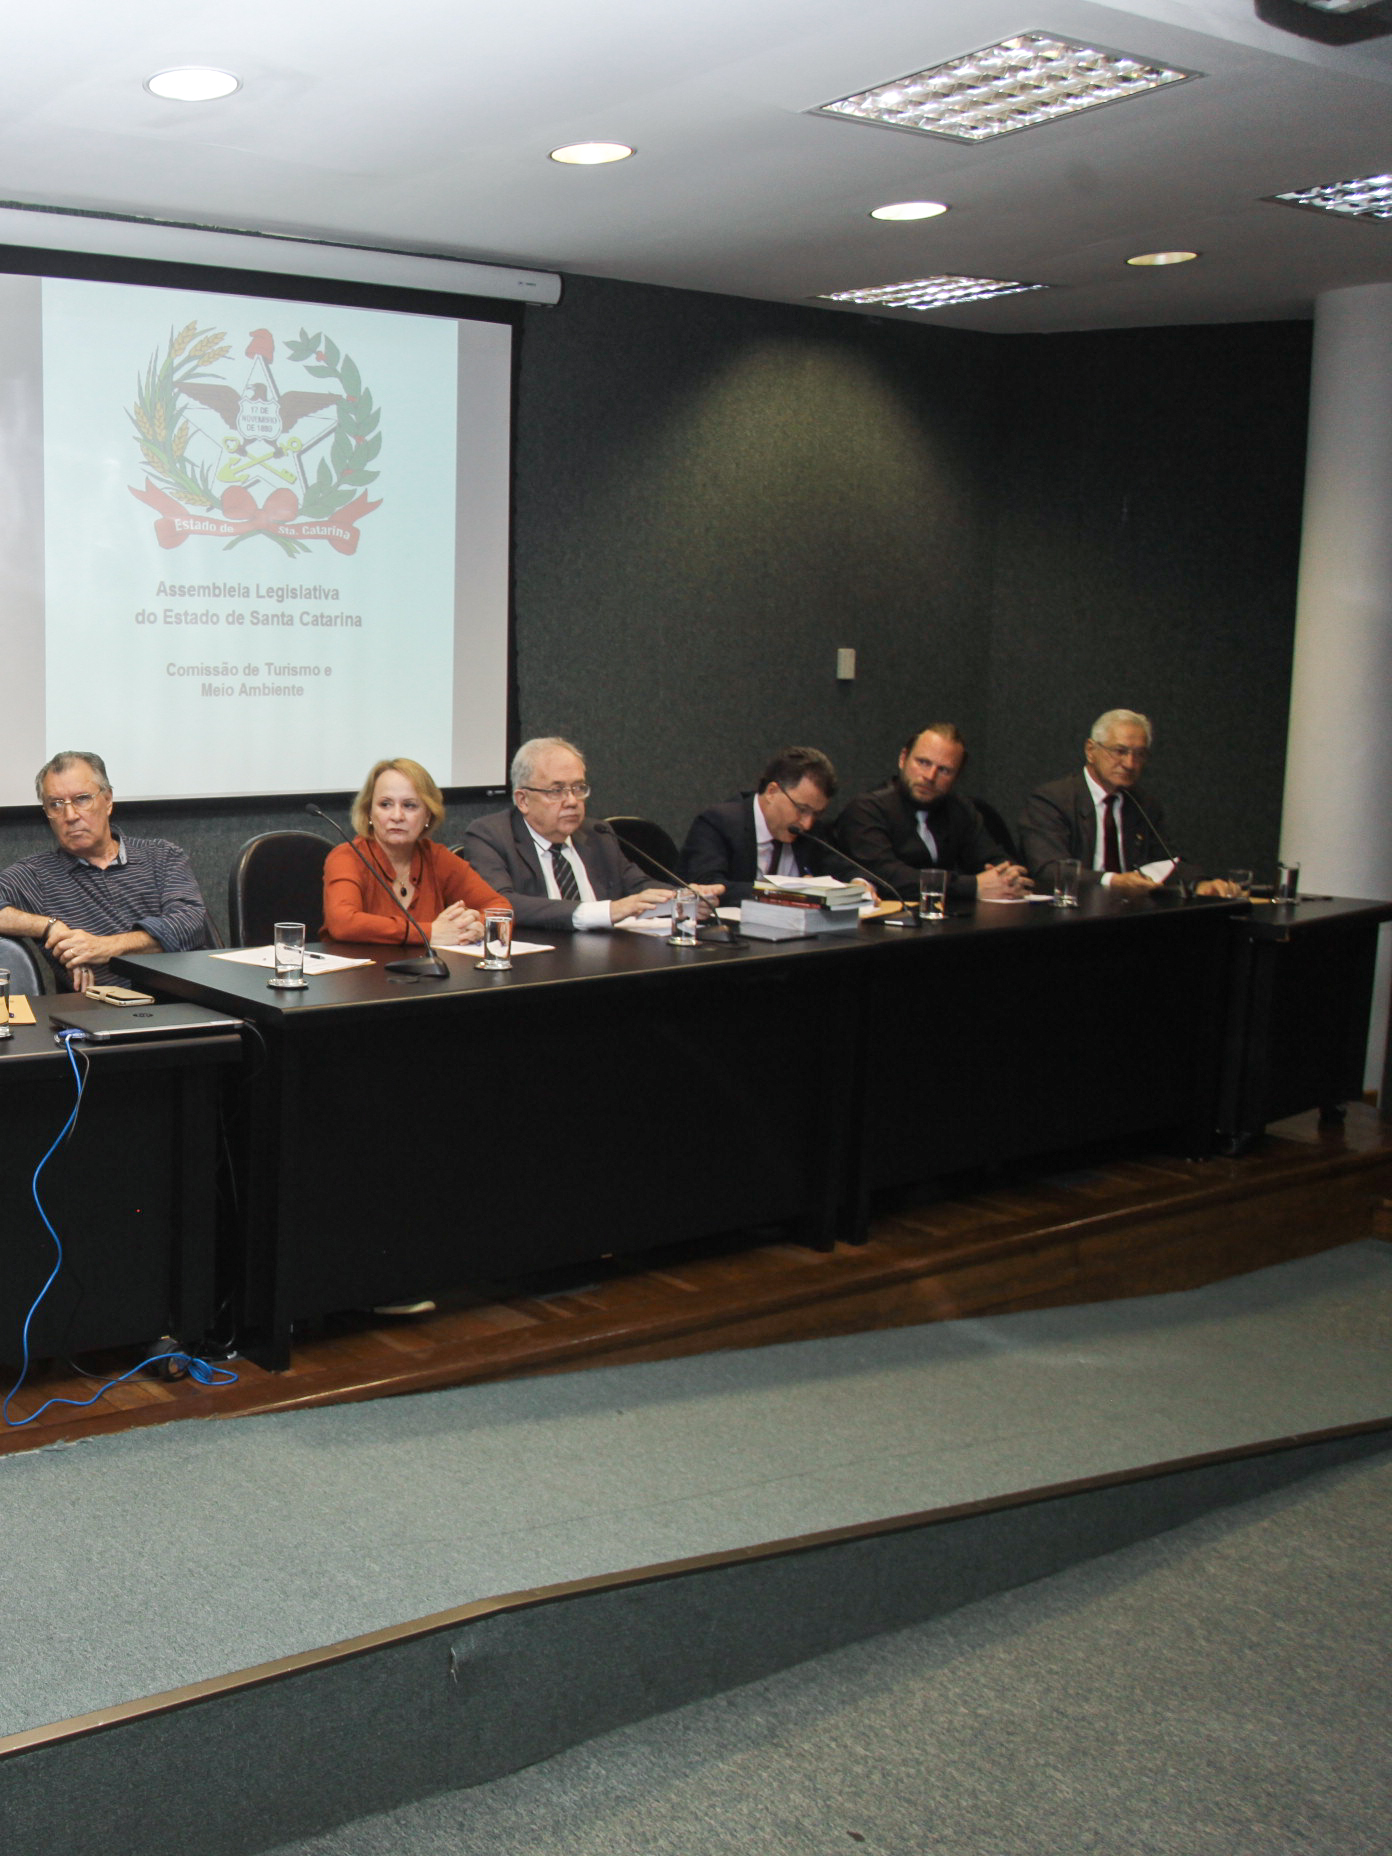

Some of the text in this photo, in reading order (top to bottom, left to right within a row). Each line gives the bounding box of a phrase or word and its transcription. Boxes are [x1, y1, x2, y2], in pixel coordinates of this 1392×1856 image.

[174, 518, 234, 533] Estado de
[278, 525, 350, 540] Sta. Catarina
[156, 581, 340, 603] Assembleia Legislativa
[135, 609, 362, 627] do Estado de Santa Catarina
[166, 662, 332, 677] Comissão de Turismo e
[201, 683, 304, 697] Meio Ambiente
